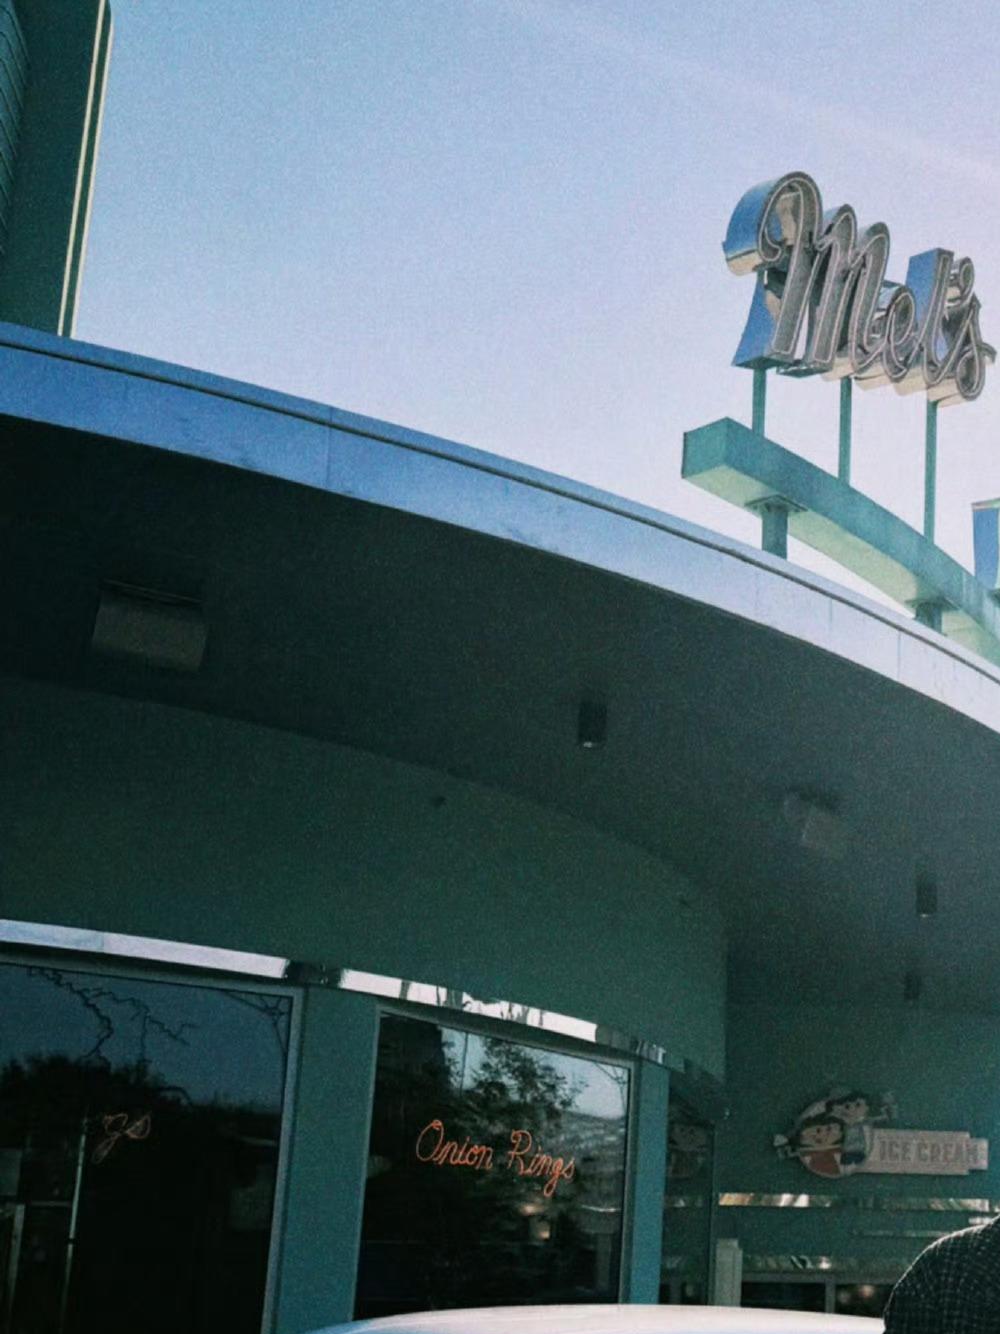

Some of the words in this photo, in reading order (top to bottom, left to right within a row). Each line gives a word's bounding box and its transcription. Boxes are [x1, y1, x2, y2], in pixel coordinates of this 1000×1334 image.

[724, 171, 997, 402] Mel's
[415, 1118, 494, 1170] Onion
[507, 1129, 576, 1197] Rings
[880, 1139, 912, 1162] ICE
[917, 1139, 979, 1164] CREAM
